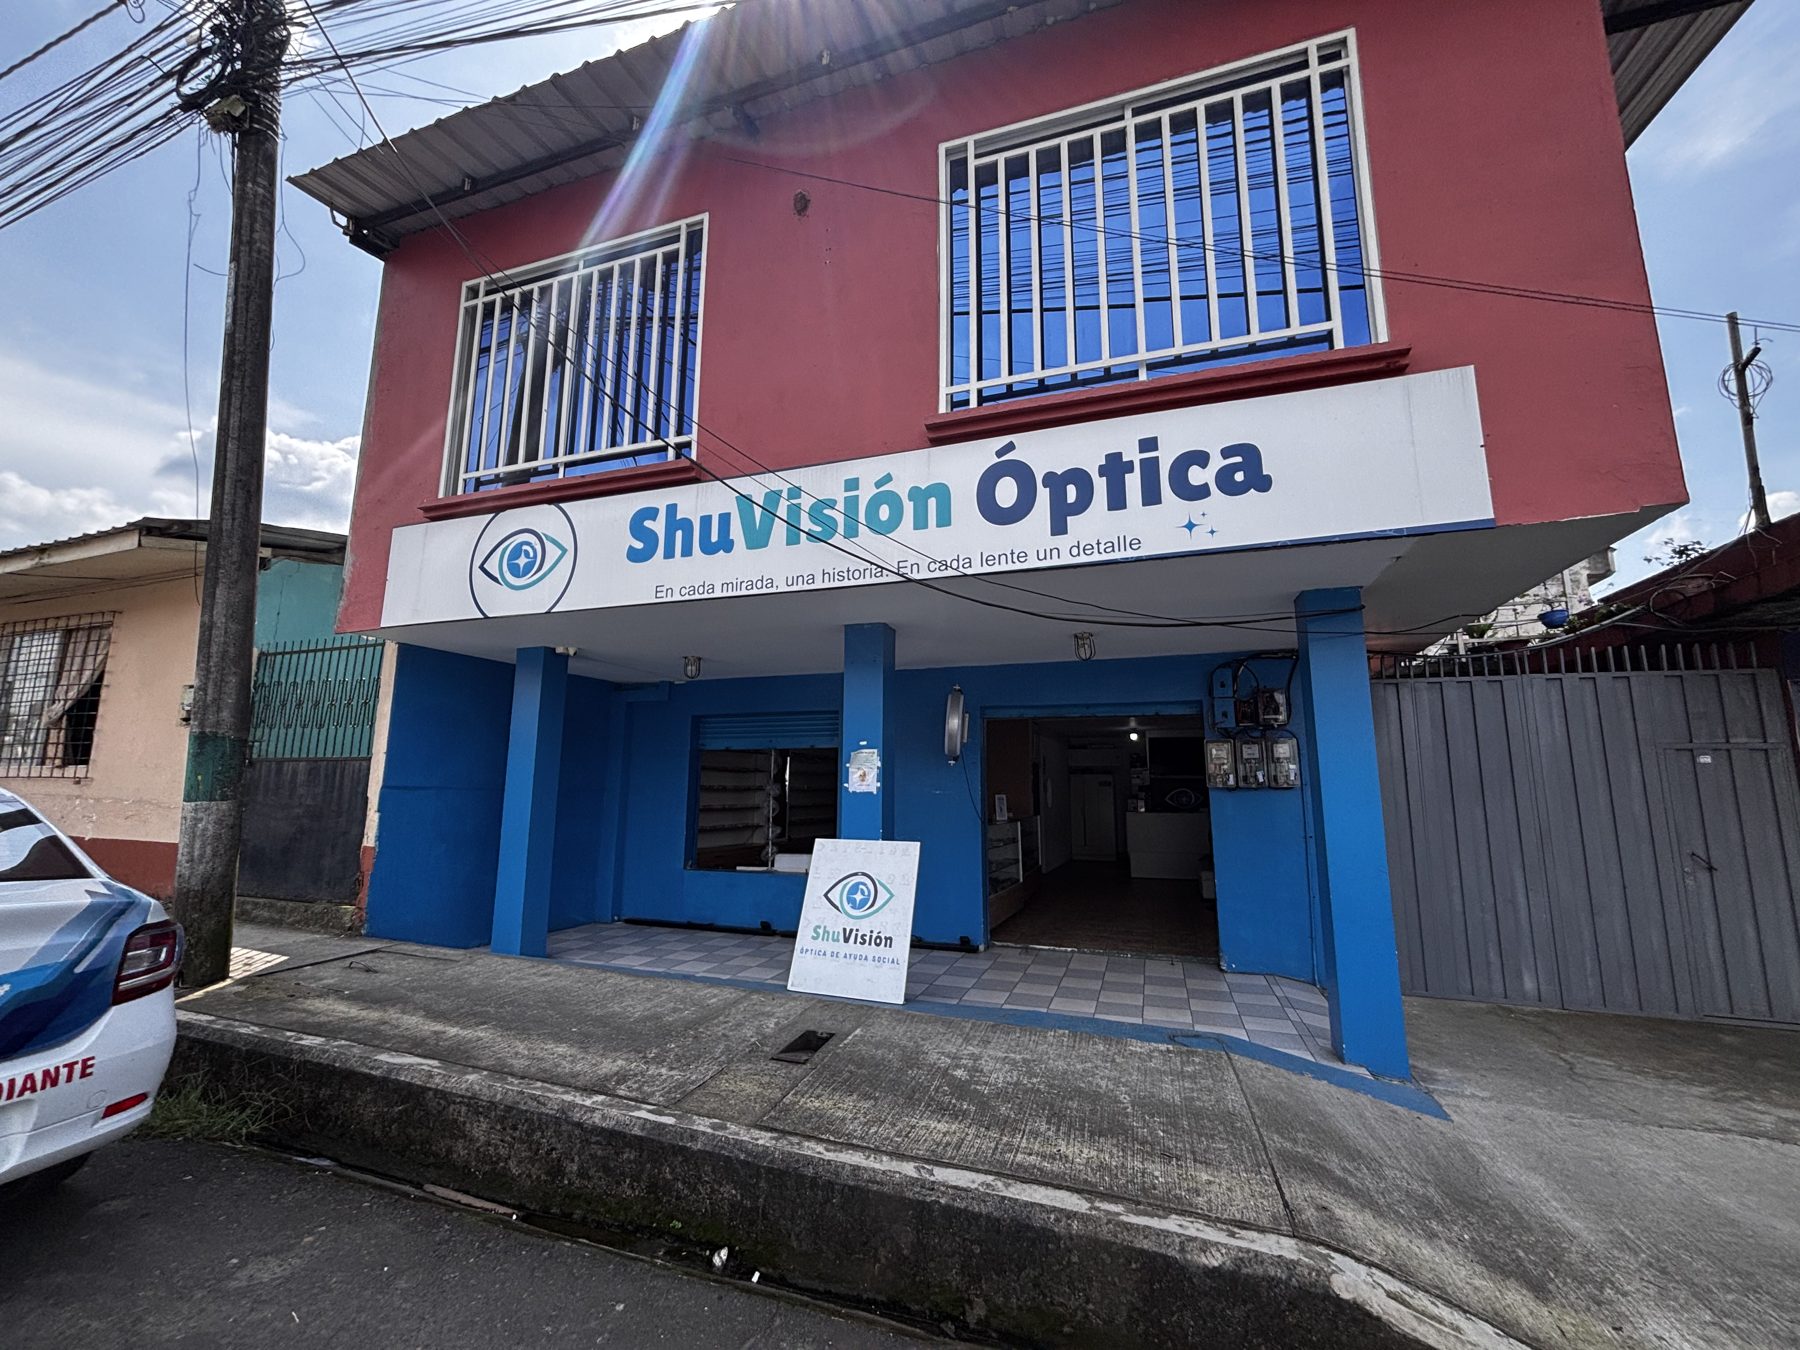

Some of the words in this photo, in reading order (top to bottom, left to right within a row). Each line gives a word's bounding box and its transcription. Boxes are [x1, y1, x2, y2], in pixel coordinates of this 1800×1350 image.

[626, 472, 952, 564] ShuVisión
[976, 435, 1273, 537] Óptica
[654, 585, 674, 599] En
[679, 580, 715, 597] cada
[720, 575, 779, 593] mirada,
[785, 571, 815, 587] una
[821, 563, 889, 584] historia.
[897, 560, 920, 576] En
[927, 554, 972, 573] cada
[980, 548, 1028, 567] lente
[1036, 546, 1060, 561] un
[1069, 534, 1142, 558] detalle
[800, 946, 827, 957] ÓPTICA
[830, 950, 840, 958] DE
[843, 952, 868, 962] AYUDA
[872, 955, 900, 966] SOCIAL
[811, 924, 893, 948] ShuVisión
